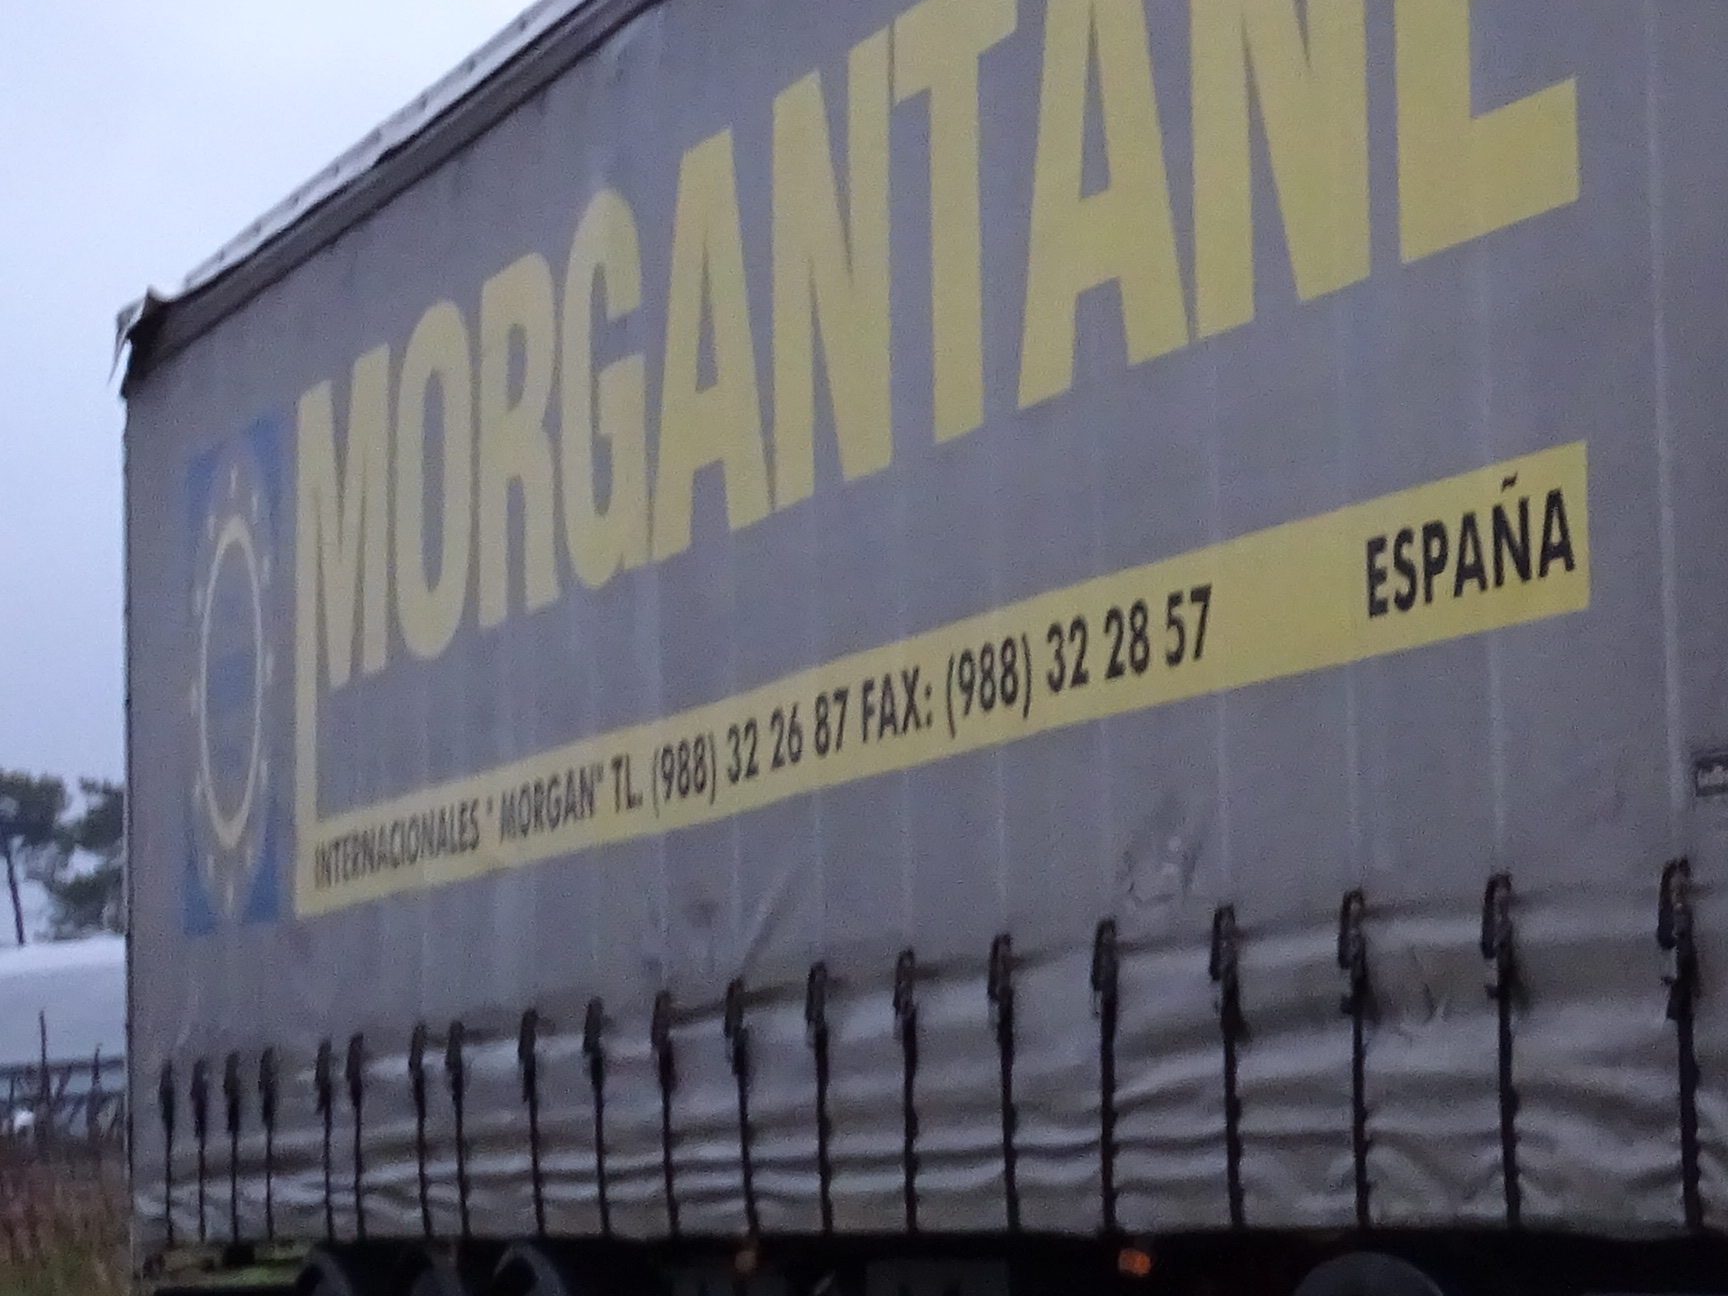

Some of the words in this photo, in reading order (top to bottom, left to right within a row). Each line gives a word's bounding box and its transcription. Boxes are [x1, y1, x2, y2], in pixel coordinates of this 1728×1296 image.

[1366, 472, 1576, 618] ESPAÑA
[314, 797, 481, 890] INTERNACIONALES
[611, 752, 643, 813] TL.
[652, 730, 717, 817] (988)
[727, 717, 759, 785] 32
[771, 704, 801, 772] 26
[814, 687, 849, 757] 87
[861, 665, 933, 744] FAX:
[946, 632, 1032, 739] (988)
[1046, 615, 1089, 694] 32
[1105, 598, 1150, 680] 28
[1165, 583, 1212, 667] 57
